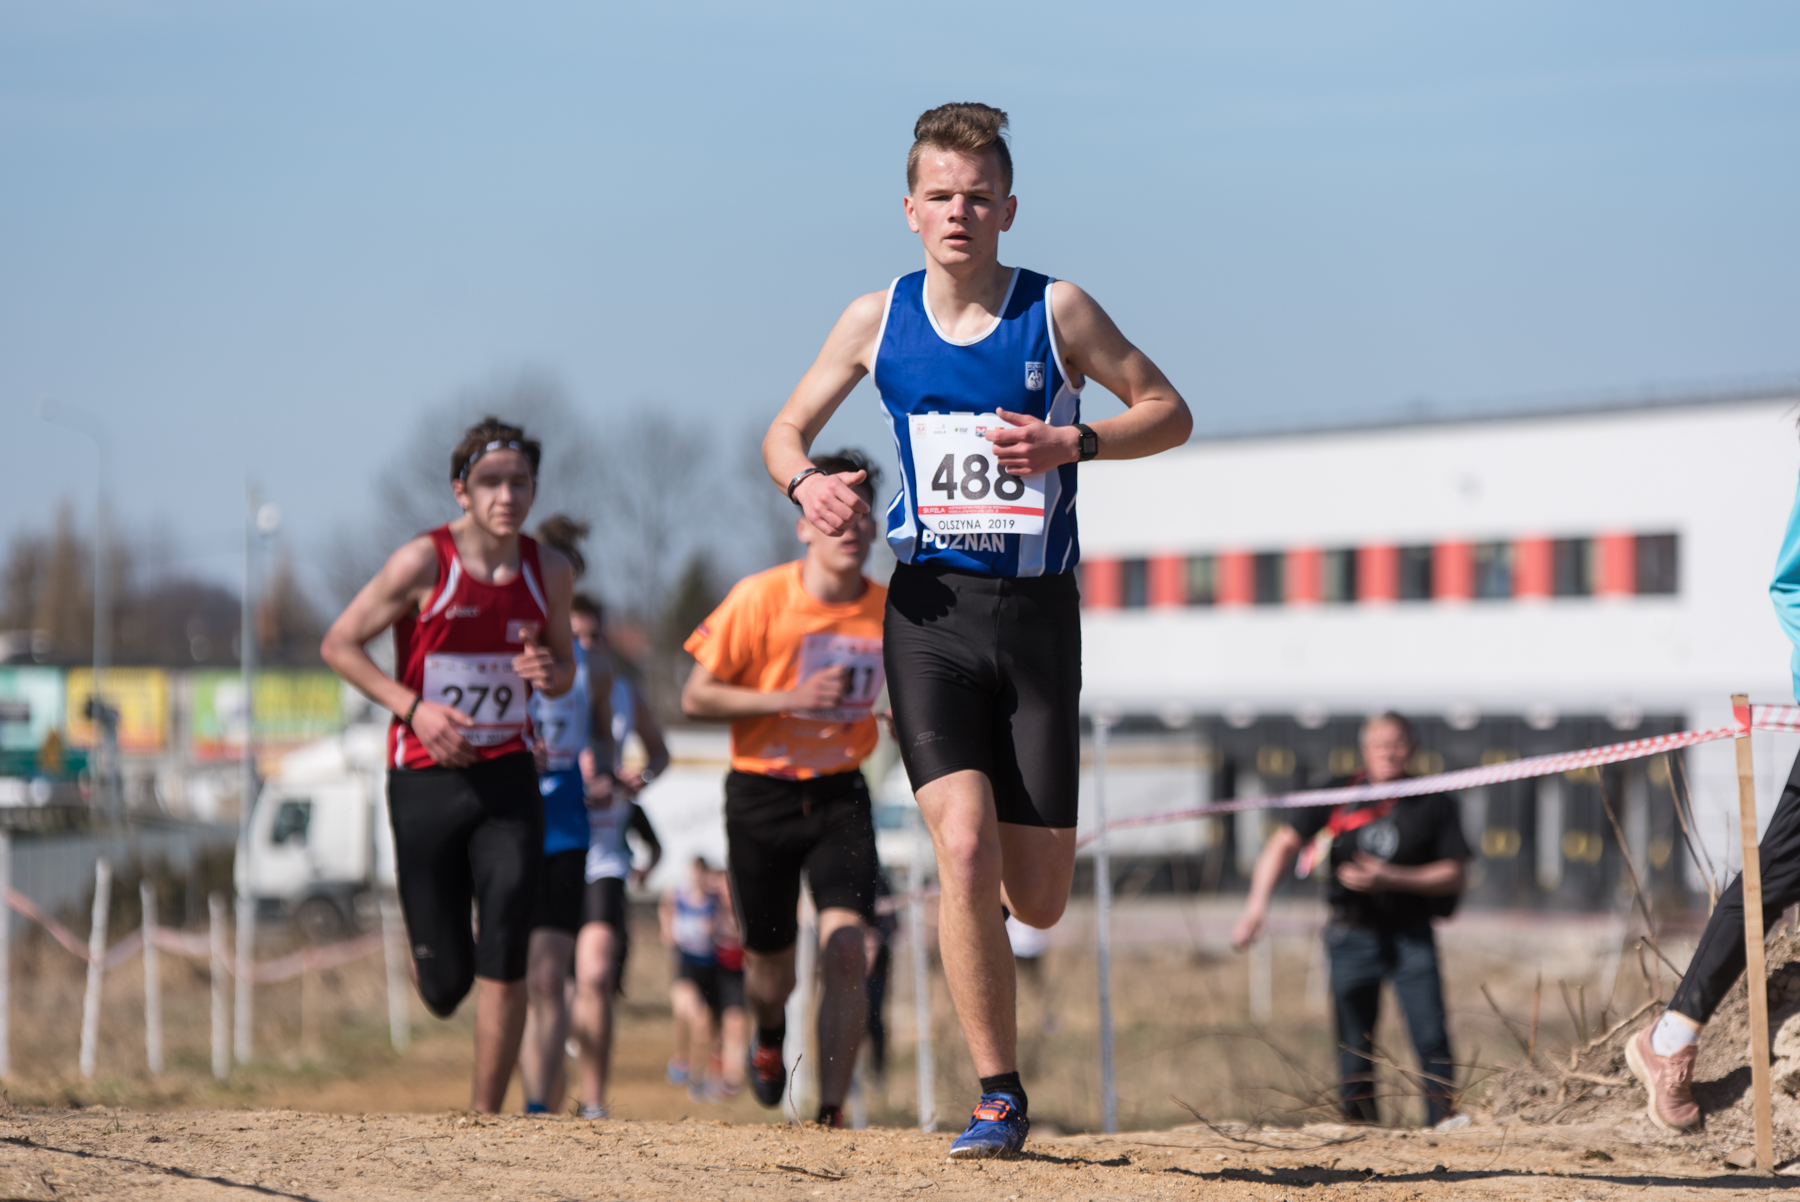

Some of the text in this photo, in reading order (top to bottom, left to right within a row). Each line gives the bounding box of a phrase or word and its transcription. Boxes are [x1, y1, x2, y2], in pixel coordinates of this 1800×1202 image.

[931, 453, 1025, 501] 488
[938, 519, 1015, 530] OLSZYNA 2019
[441, 685, 513, 720] 279
